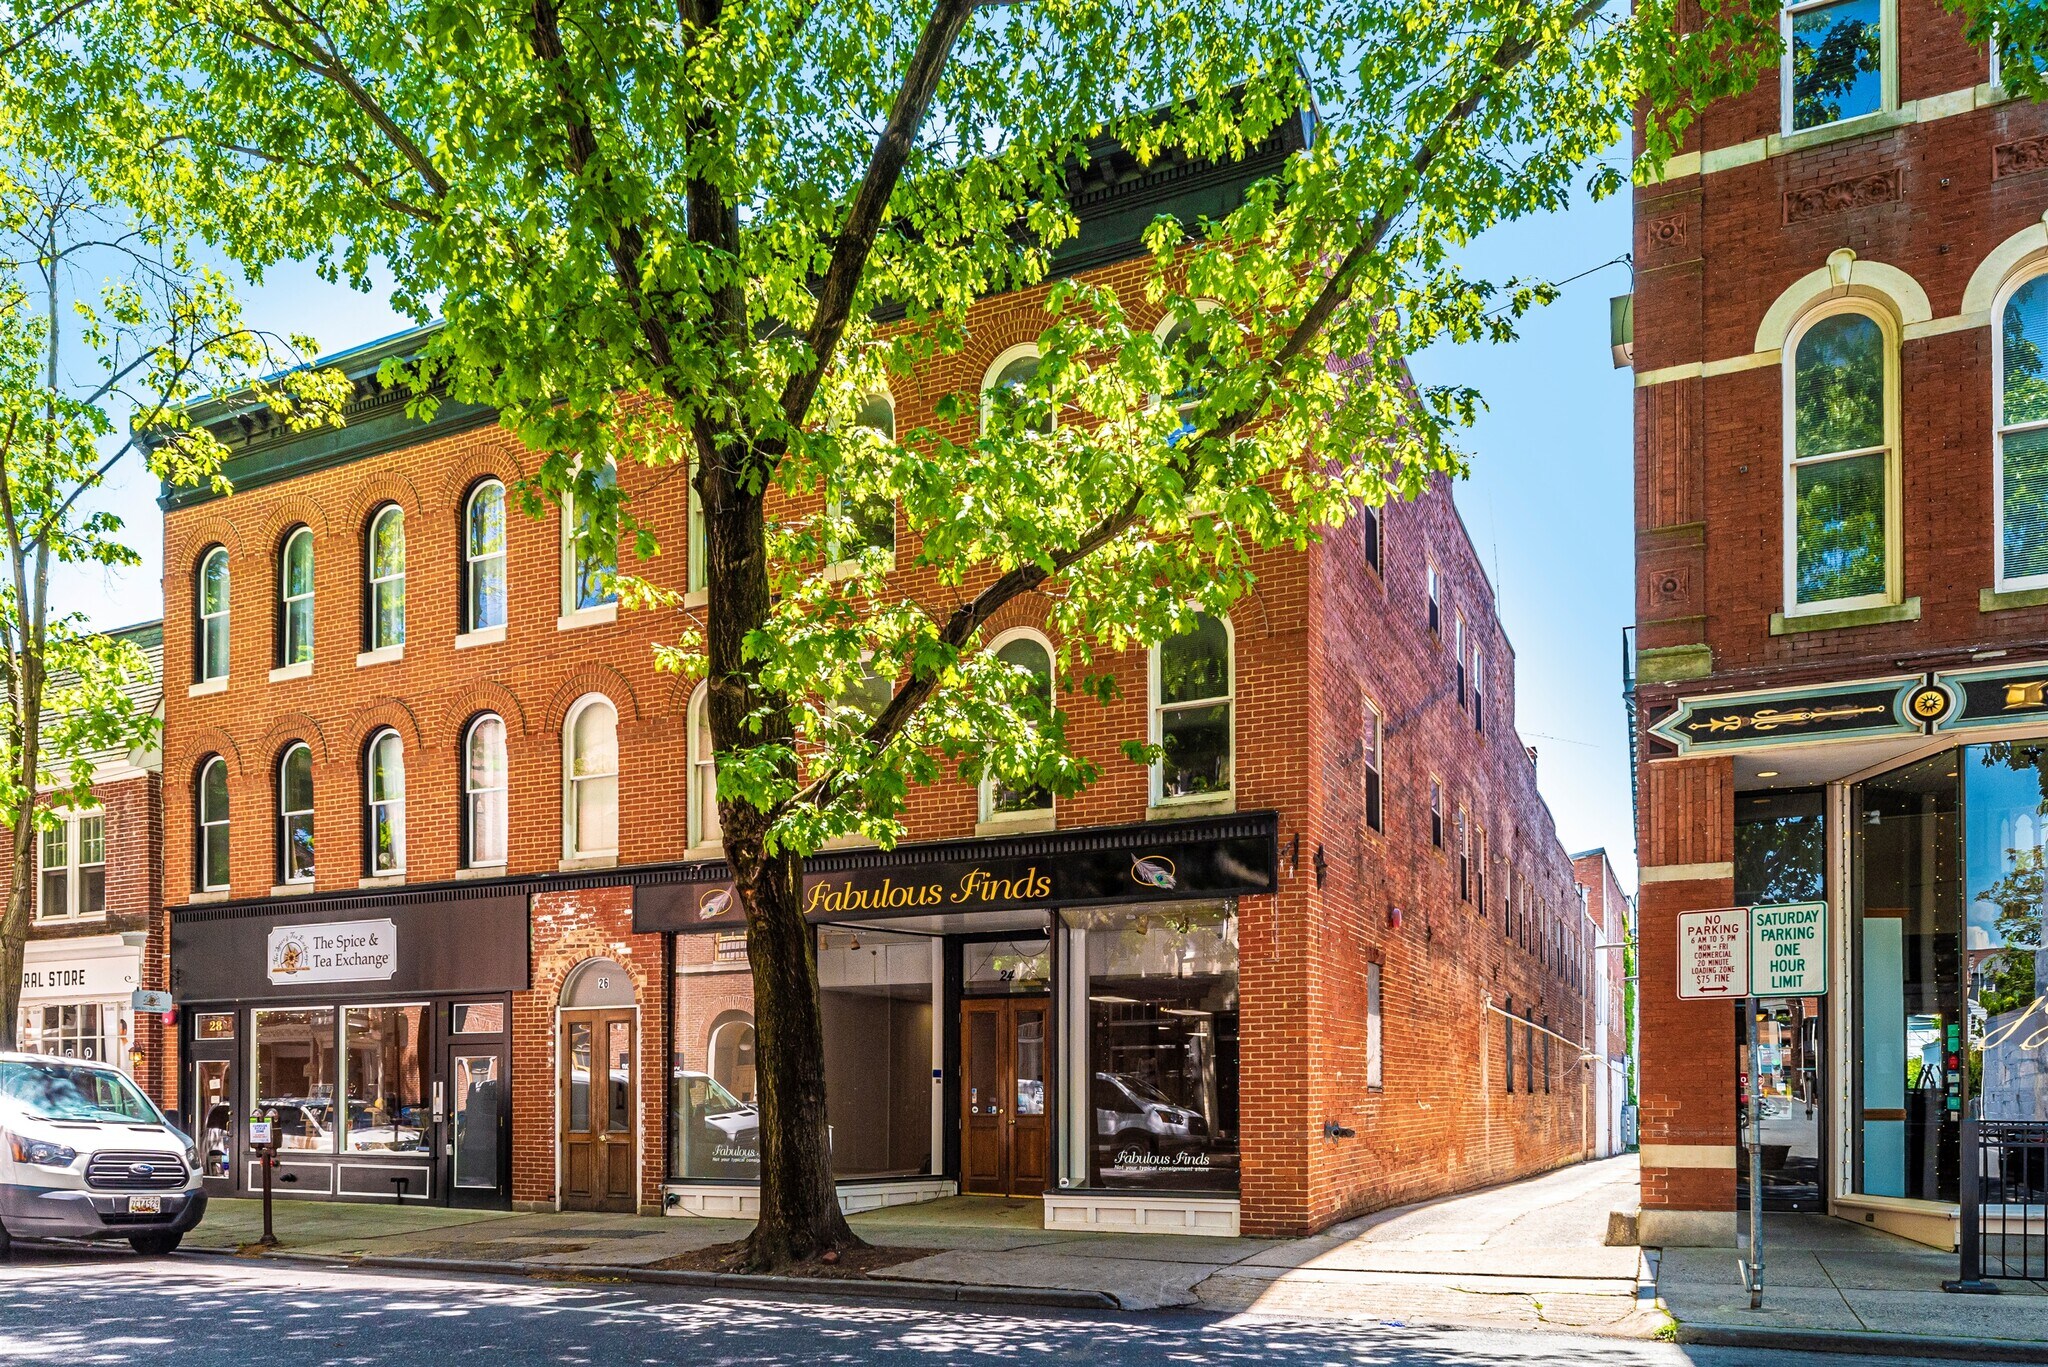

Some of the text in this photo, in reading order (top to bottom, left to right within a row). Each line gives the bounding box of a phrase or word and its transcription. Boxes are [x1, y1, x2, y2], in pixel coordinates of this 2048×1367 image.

[803, 867, 1052, 914] Fabulous Finds
[1705, 914, 1721, 925] NO
[1757, 910, 1819, 926] SATURDAY
[1687, 923, 1739, 936] PARKING
[1761, 926, 1815, 941] PARKING
[313, 932, 379, 952] The Spice &
[1709, 935, 1717, 943] TO
[1694, 950, 1732, 960] COMMERCIAL
[1774, 943, 1801, 957] ONE
[313, 952, 389, 969] Tea Exchange
[1697, 958, 1729, 967] 20 MINUTE
[1770, 958, 1806, 973] HOUR
[1000, 969, 1015, 982] 24
[1691, 966, 1717, 975] LOADING
[24, 969, 86, 988] RAL STORE
[599, 978, 609, 989] 26
[1696, 974, 1730, 985] $75 FINE
[1771, 974, 1804, 989] LIMIT
[209, 1020, 223, 1031] 28
[712, 1144, 756, 1157] Fabulous
[1114, 1149, 1210, 1166] Fabulous Finds
[1158, 1165, 1193, 1173] consignment
